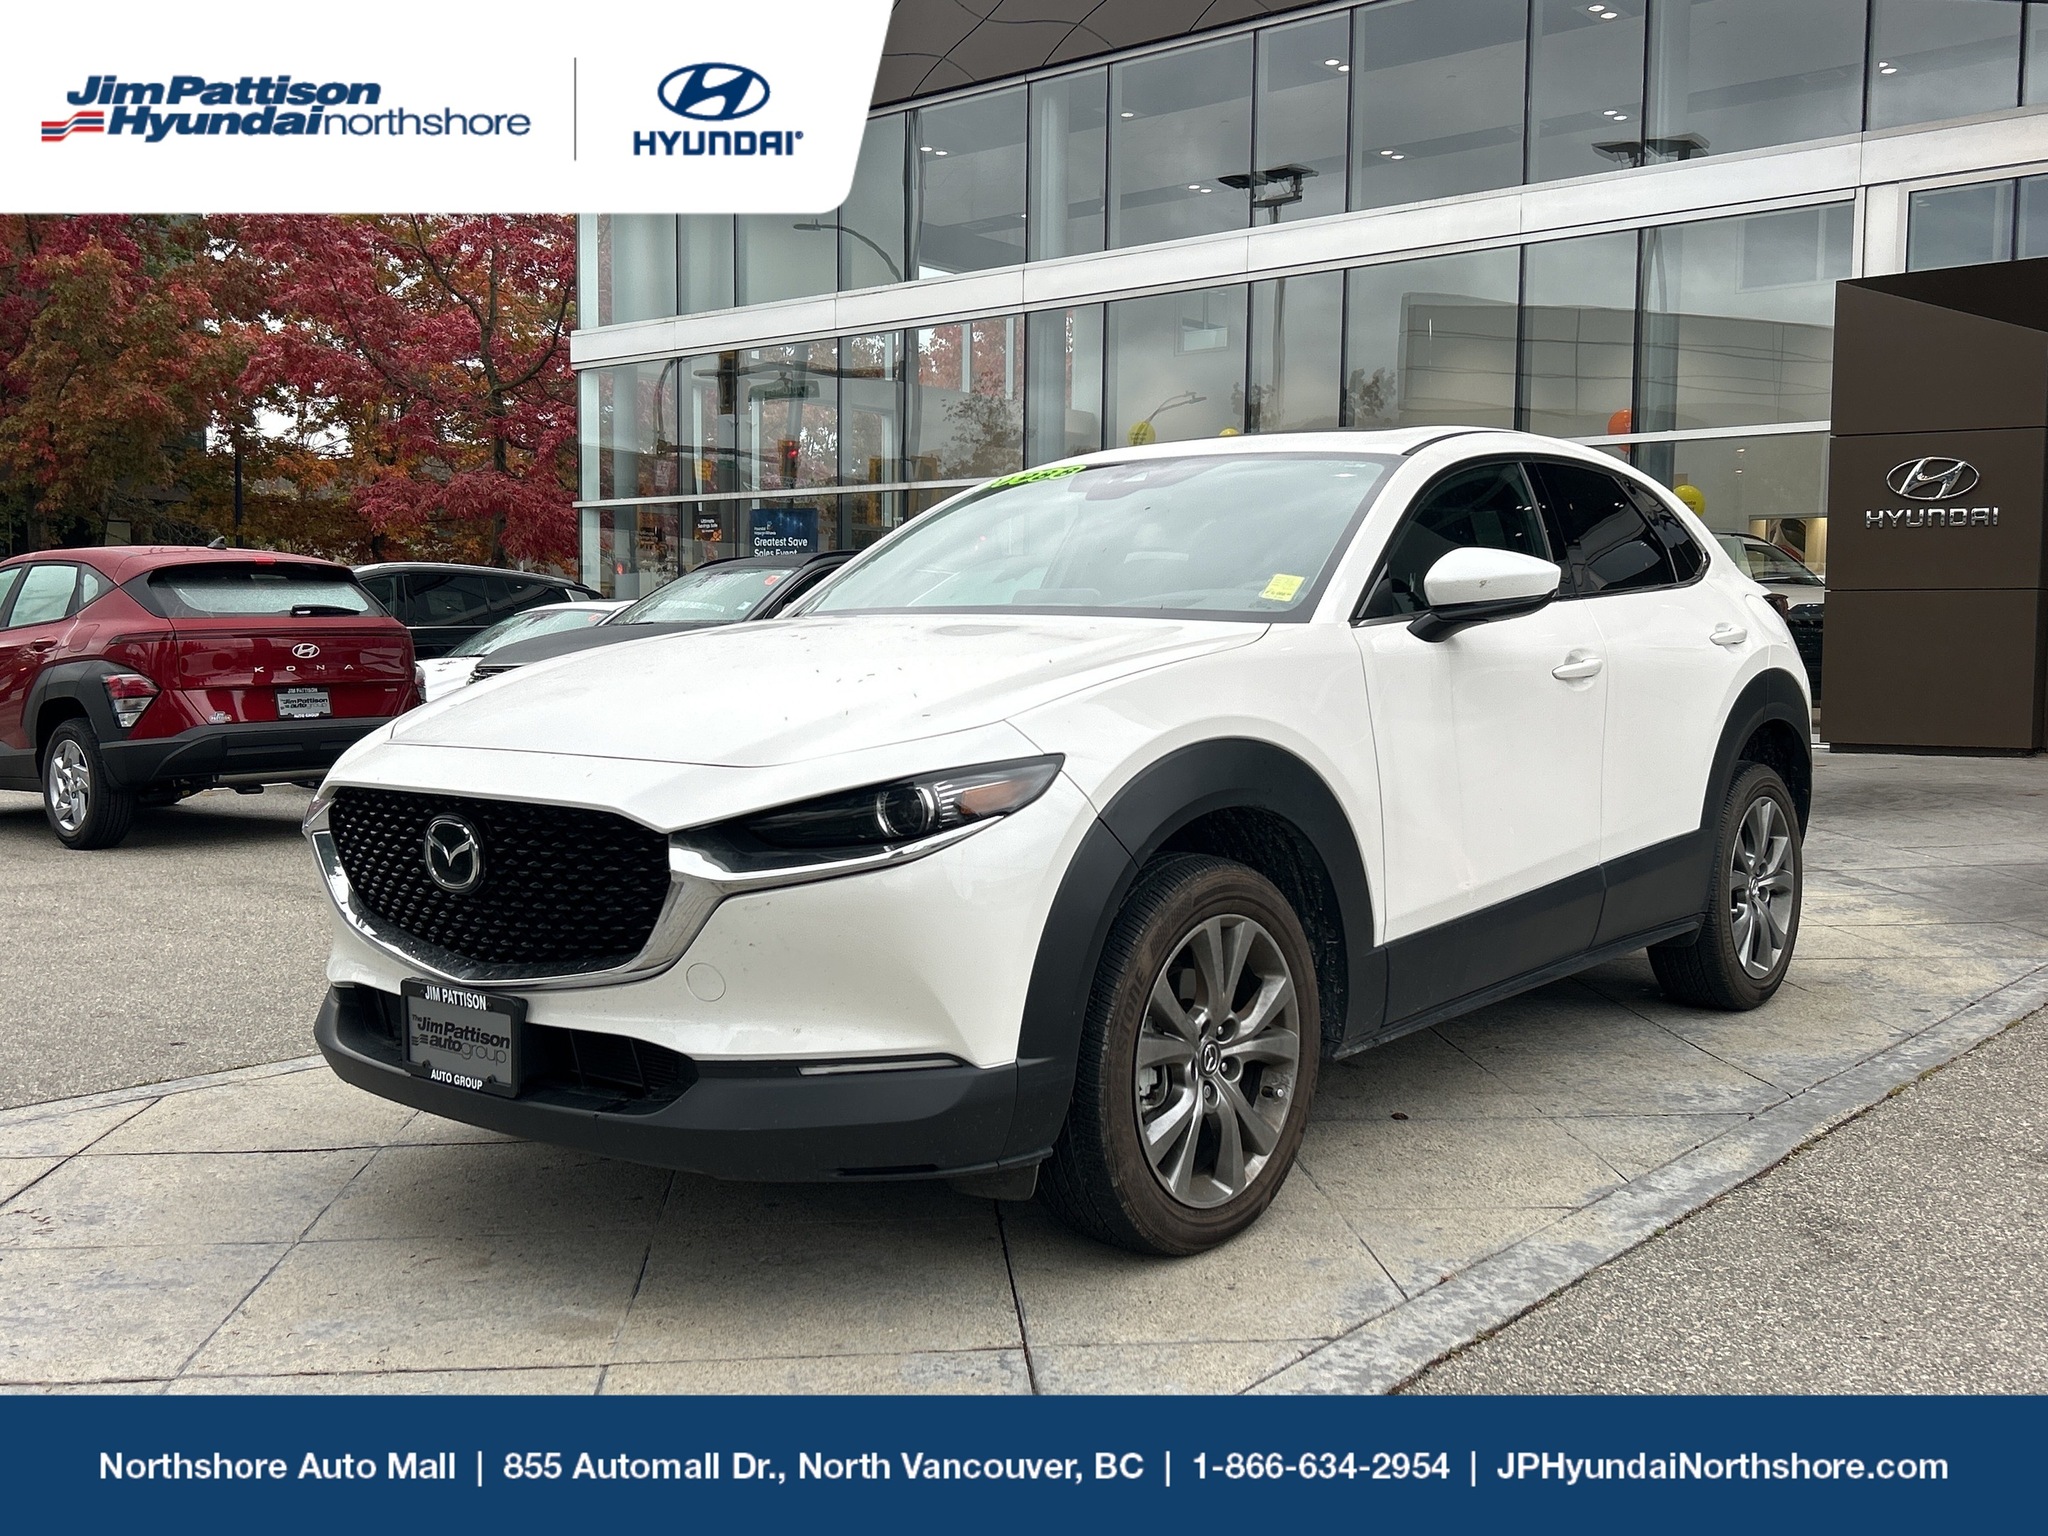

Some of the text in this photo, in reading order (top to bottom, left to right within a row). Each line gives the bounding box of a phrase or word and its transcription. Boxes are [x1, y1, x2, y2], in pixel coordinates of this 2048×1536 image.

[1865, 507, 1999, 529] HYUNDAI
[754, 536, 808, 548] Greatest Save
[754, 548, 798, 557] Sales Event
[254, 664, 354, 673] KONA
[424, 985, 487, 1011] JIM PATTISON
[412, 1013, 423, 1023] The
[430, 1068, 483, 1091] AUTO GROUP
